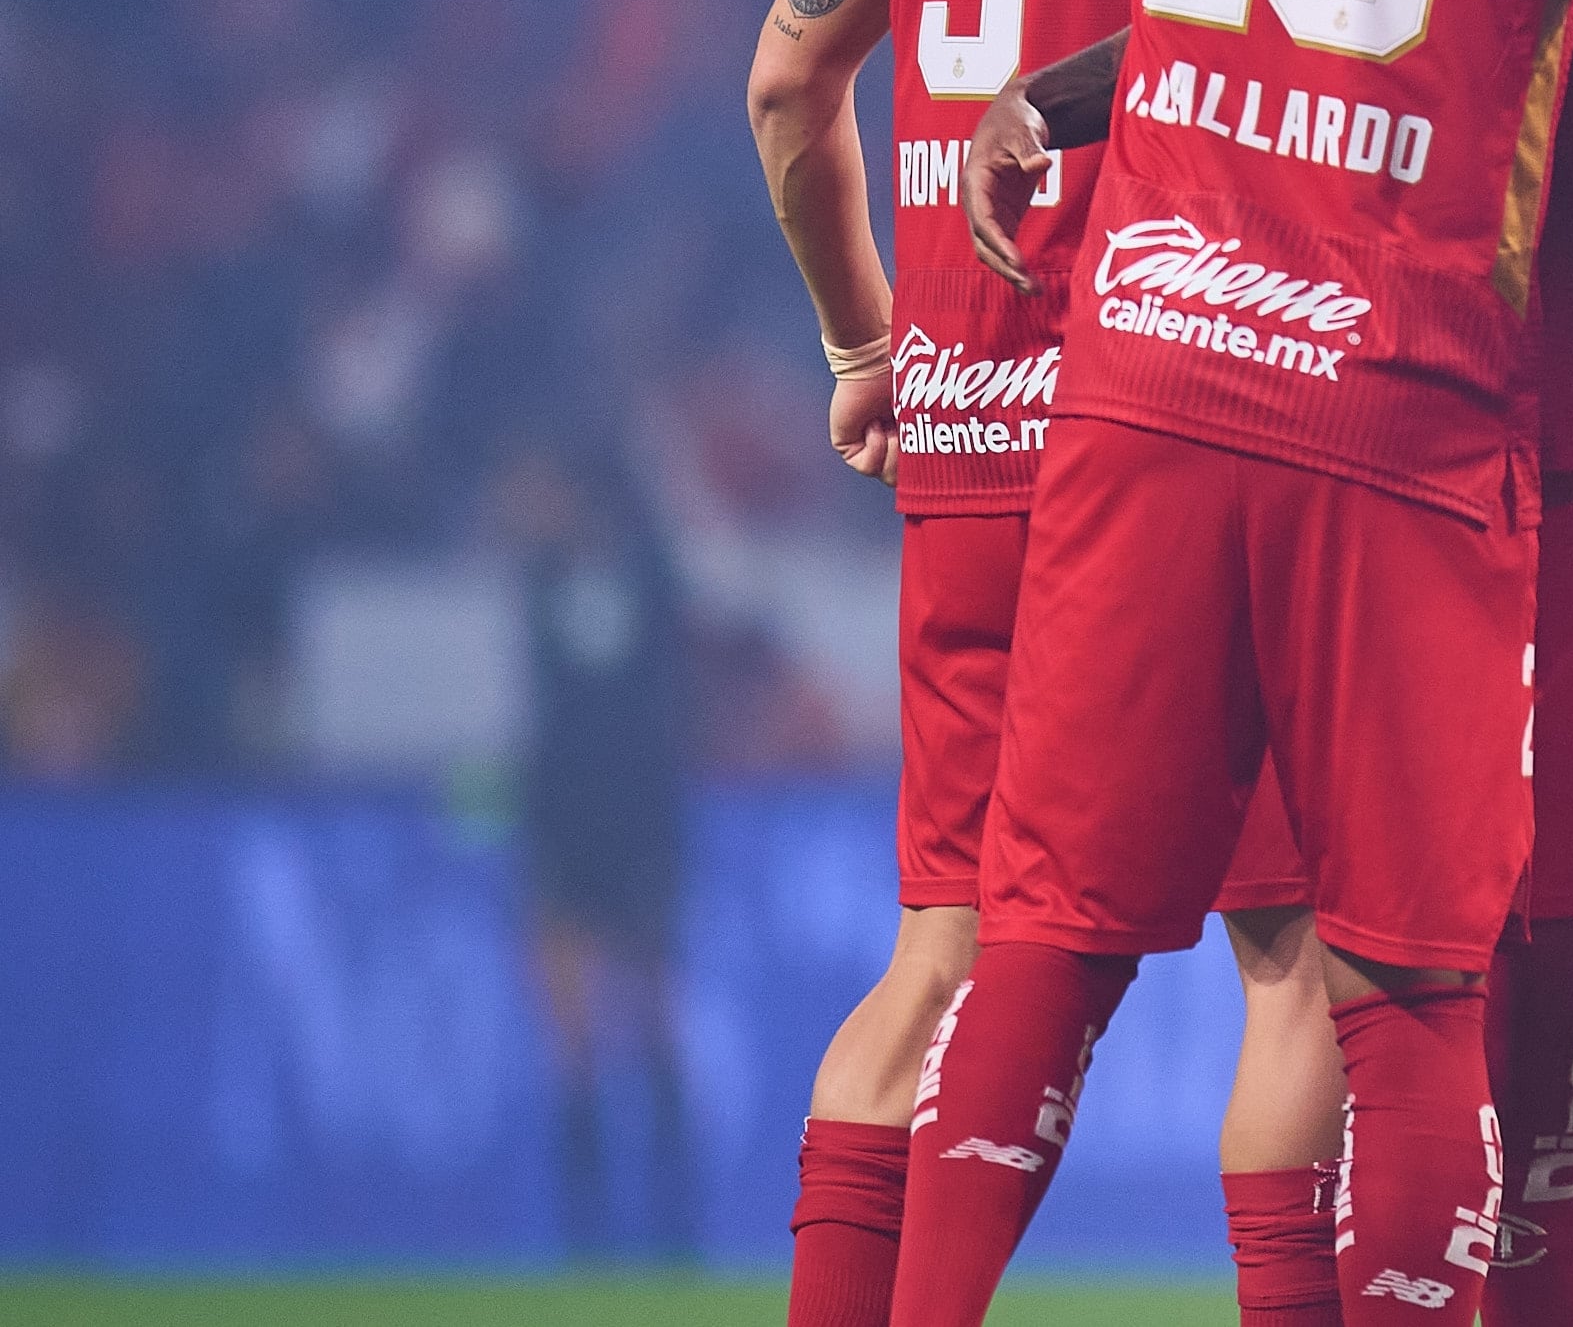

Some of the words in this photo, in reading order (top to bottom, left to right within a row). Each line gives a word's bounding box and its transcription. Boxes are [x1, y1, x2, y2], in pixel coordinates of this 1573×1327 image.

[899, 139, 1063, 207] ROMO
[1094, 214, 1372, 332] Caliente
[1099, 292, 1346, 382] caliente.mx
[899, 413, 1051, 454] caliente.m
